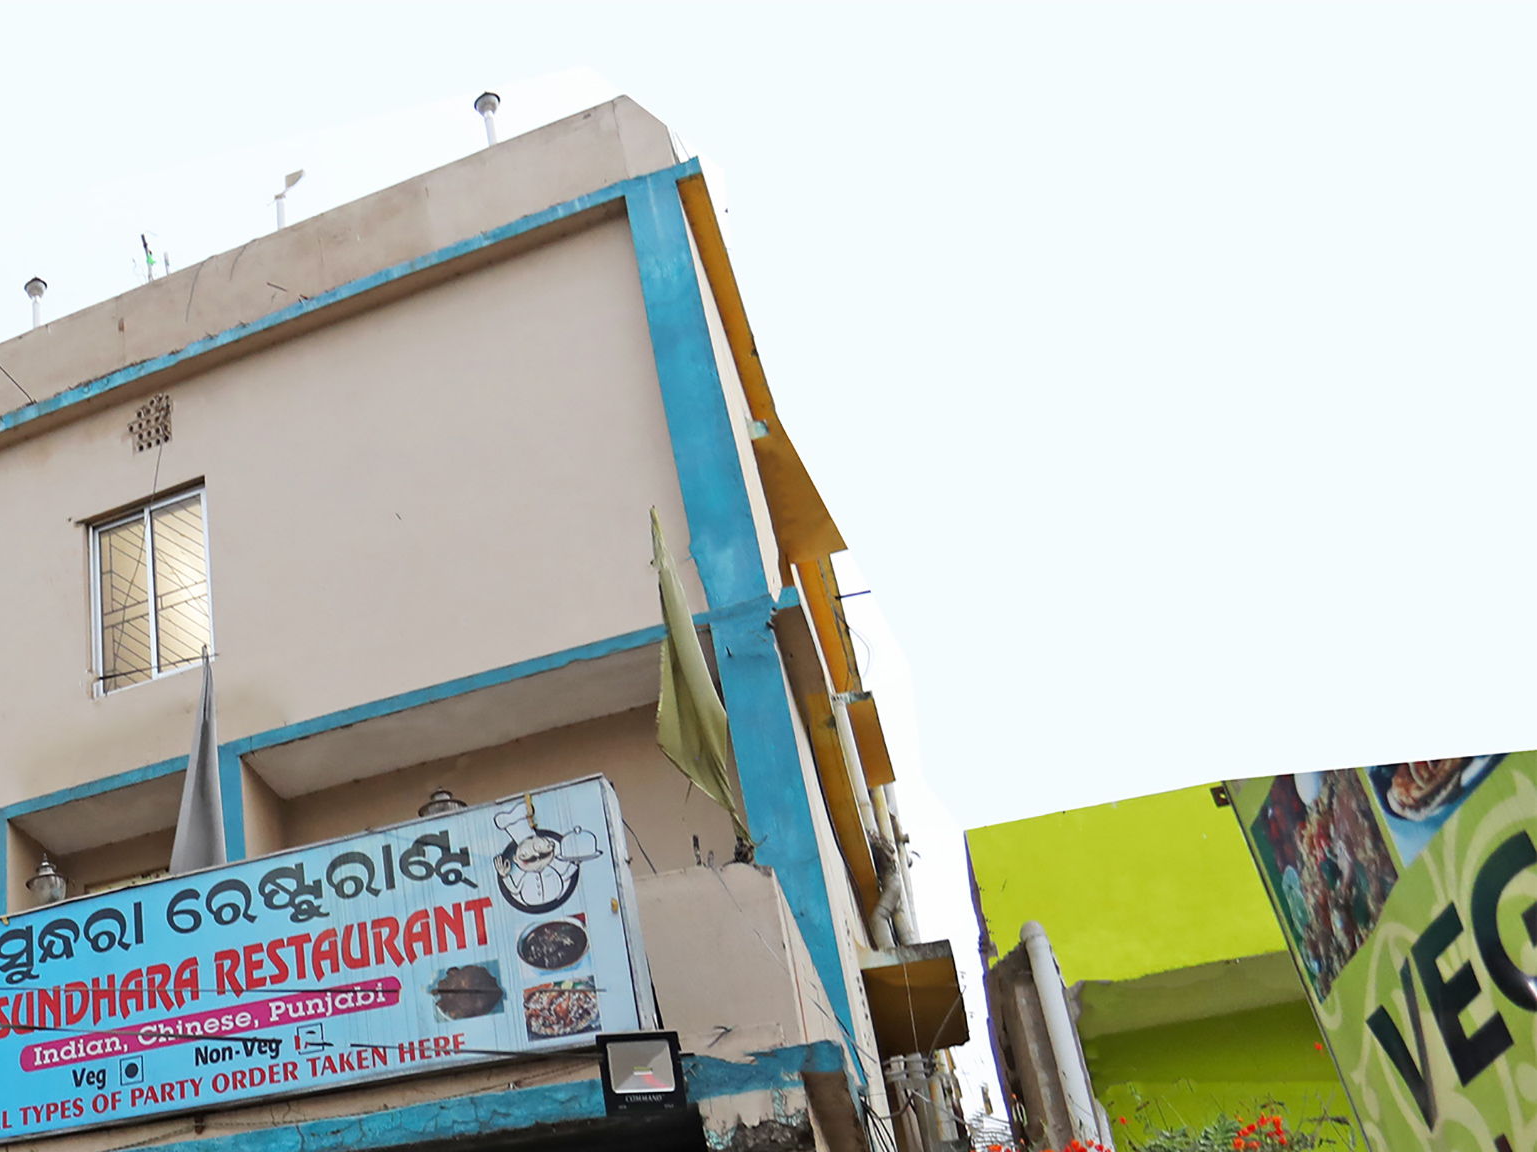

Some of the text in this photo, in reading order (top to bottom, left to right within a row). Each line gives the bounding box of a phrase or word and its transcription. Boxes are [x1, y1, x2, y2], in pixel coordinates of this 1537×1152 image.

[213, 897, 493, 1000] RESTAURANT
[33, 982, 386, 1067] Indian, Chinese, Punjabi
[194, 1038, 282, 1067] Non-Veg
[20, 1098, 84, 1127] TYPES
[100, 1089, 127, 1112] OF
[130, 1077, 204, 1109] PARTY
[211, 1062, 299, 1094] ORDER
[306, 1046, 388, 1078] TAKEN
[398, 1033, 468, 1064] HERE
[72, 1067, 107, 1090] Veg
